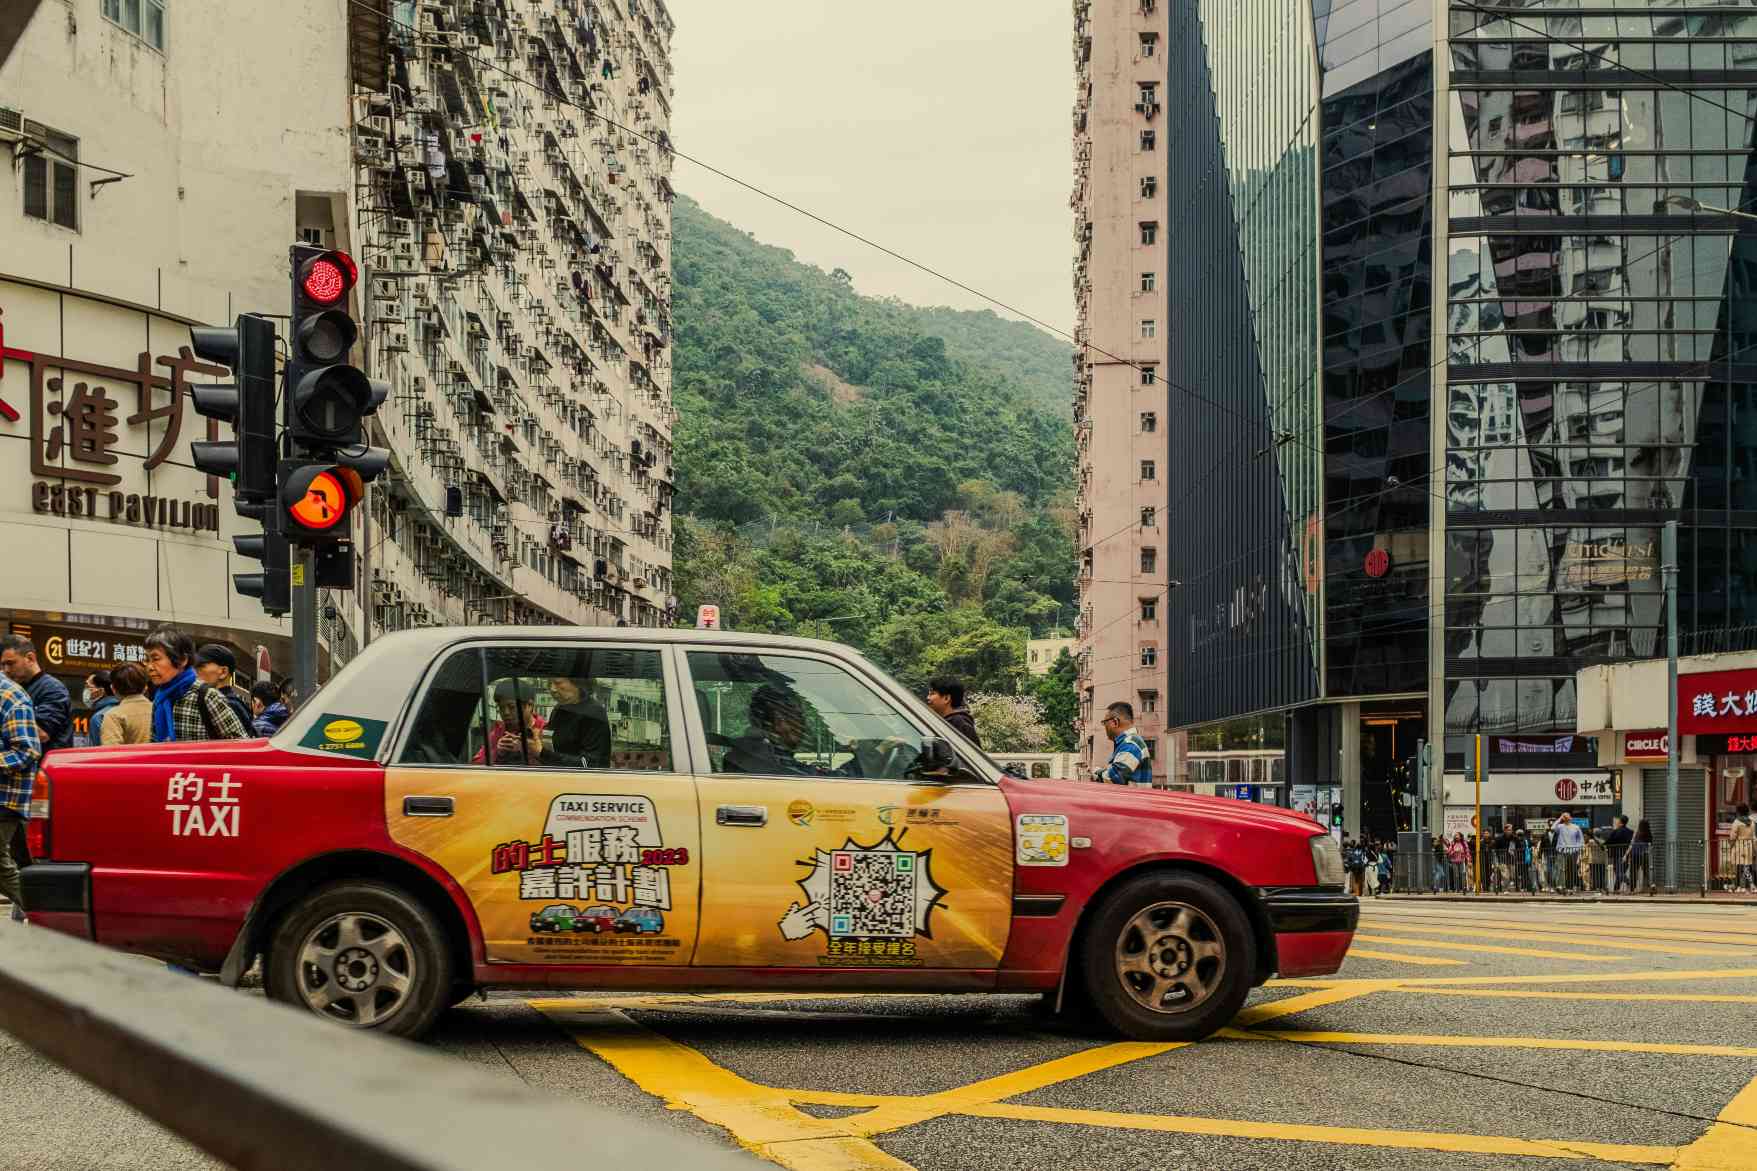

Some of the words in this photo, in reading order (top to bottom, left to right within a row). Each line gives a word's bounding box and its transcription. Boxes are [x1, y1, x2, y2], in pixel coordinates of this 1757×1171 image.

[1626, 738, 1659, 751] CIRCLE
[167, 772, 243, 802] 的士
[559, 801, 589, 812] TAXI
[592, 802, 645, 813] SERVICE
[165, 804, 241, 837] TAXI
[641, 847, 689, 866] 2023
[520, 865, 672, 911] 嘉許計劃
